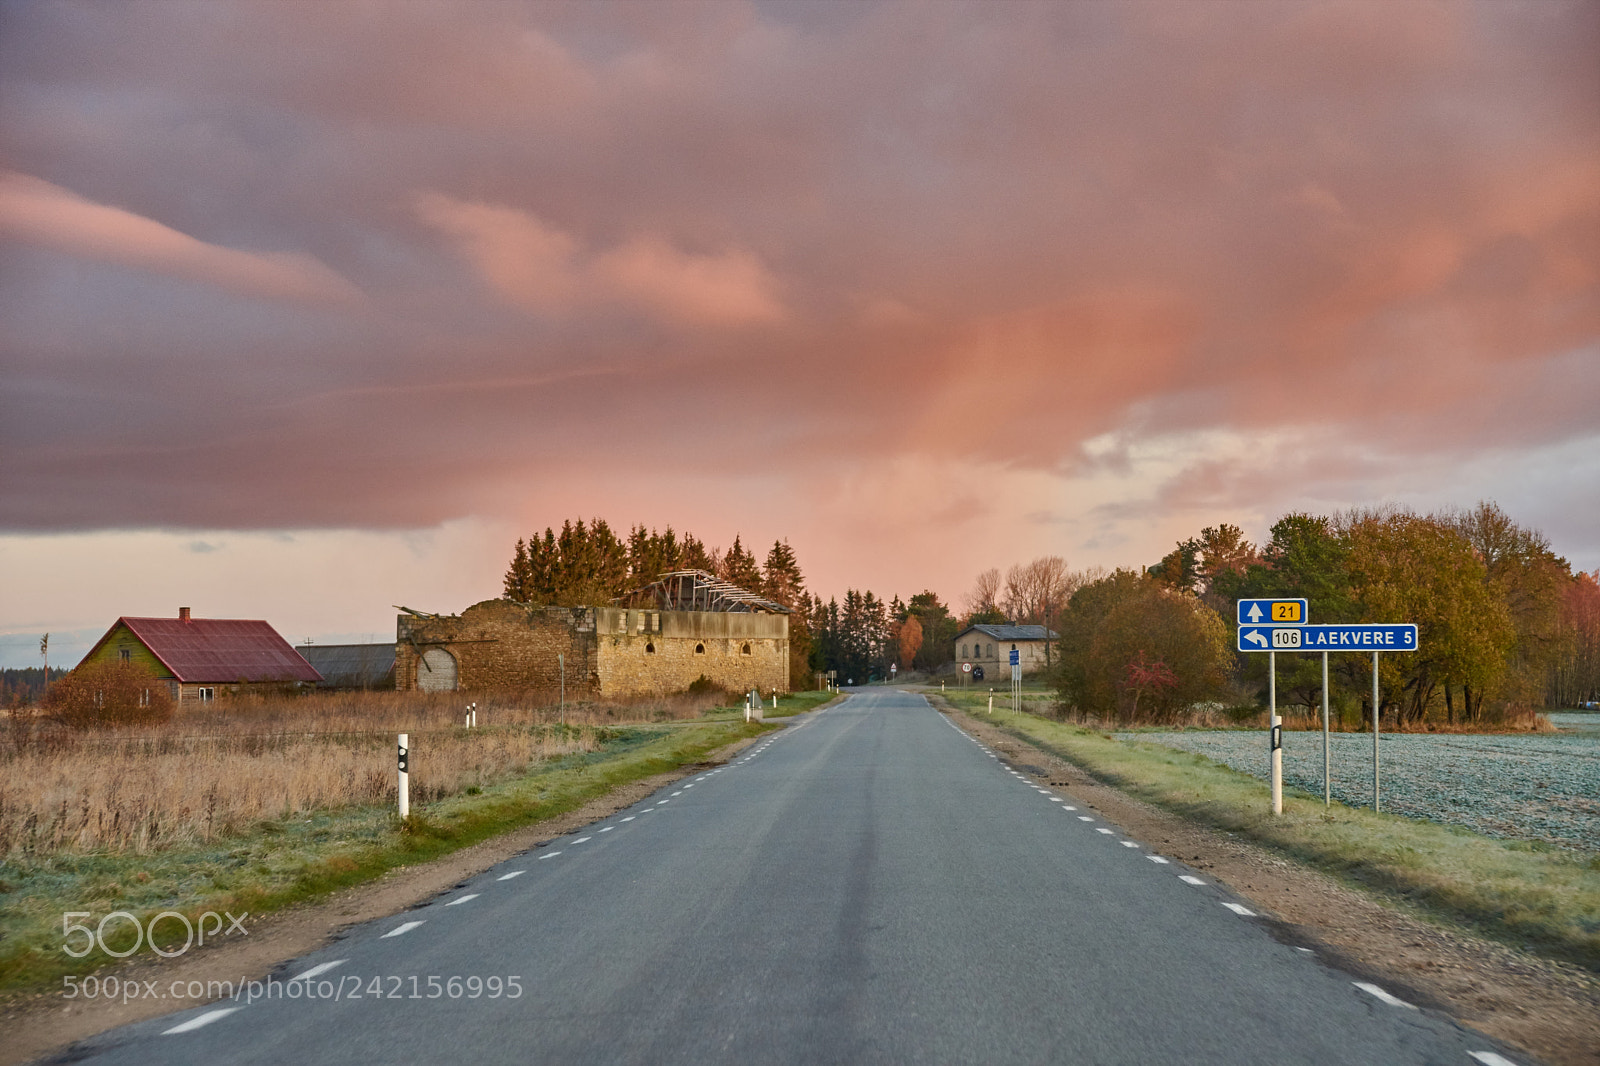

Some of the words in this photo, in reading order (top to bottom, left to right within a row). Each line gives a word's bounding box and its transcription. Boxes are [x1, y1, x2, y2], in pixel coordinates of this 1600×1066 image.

[1279, 606, 1294, 618] 21
[1274, 632, 1298, 645] 106
[1305, 631, 1395, 645] LAEKVERE
[1403, 631, 1413, 644] 5
